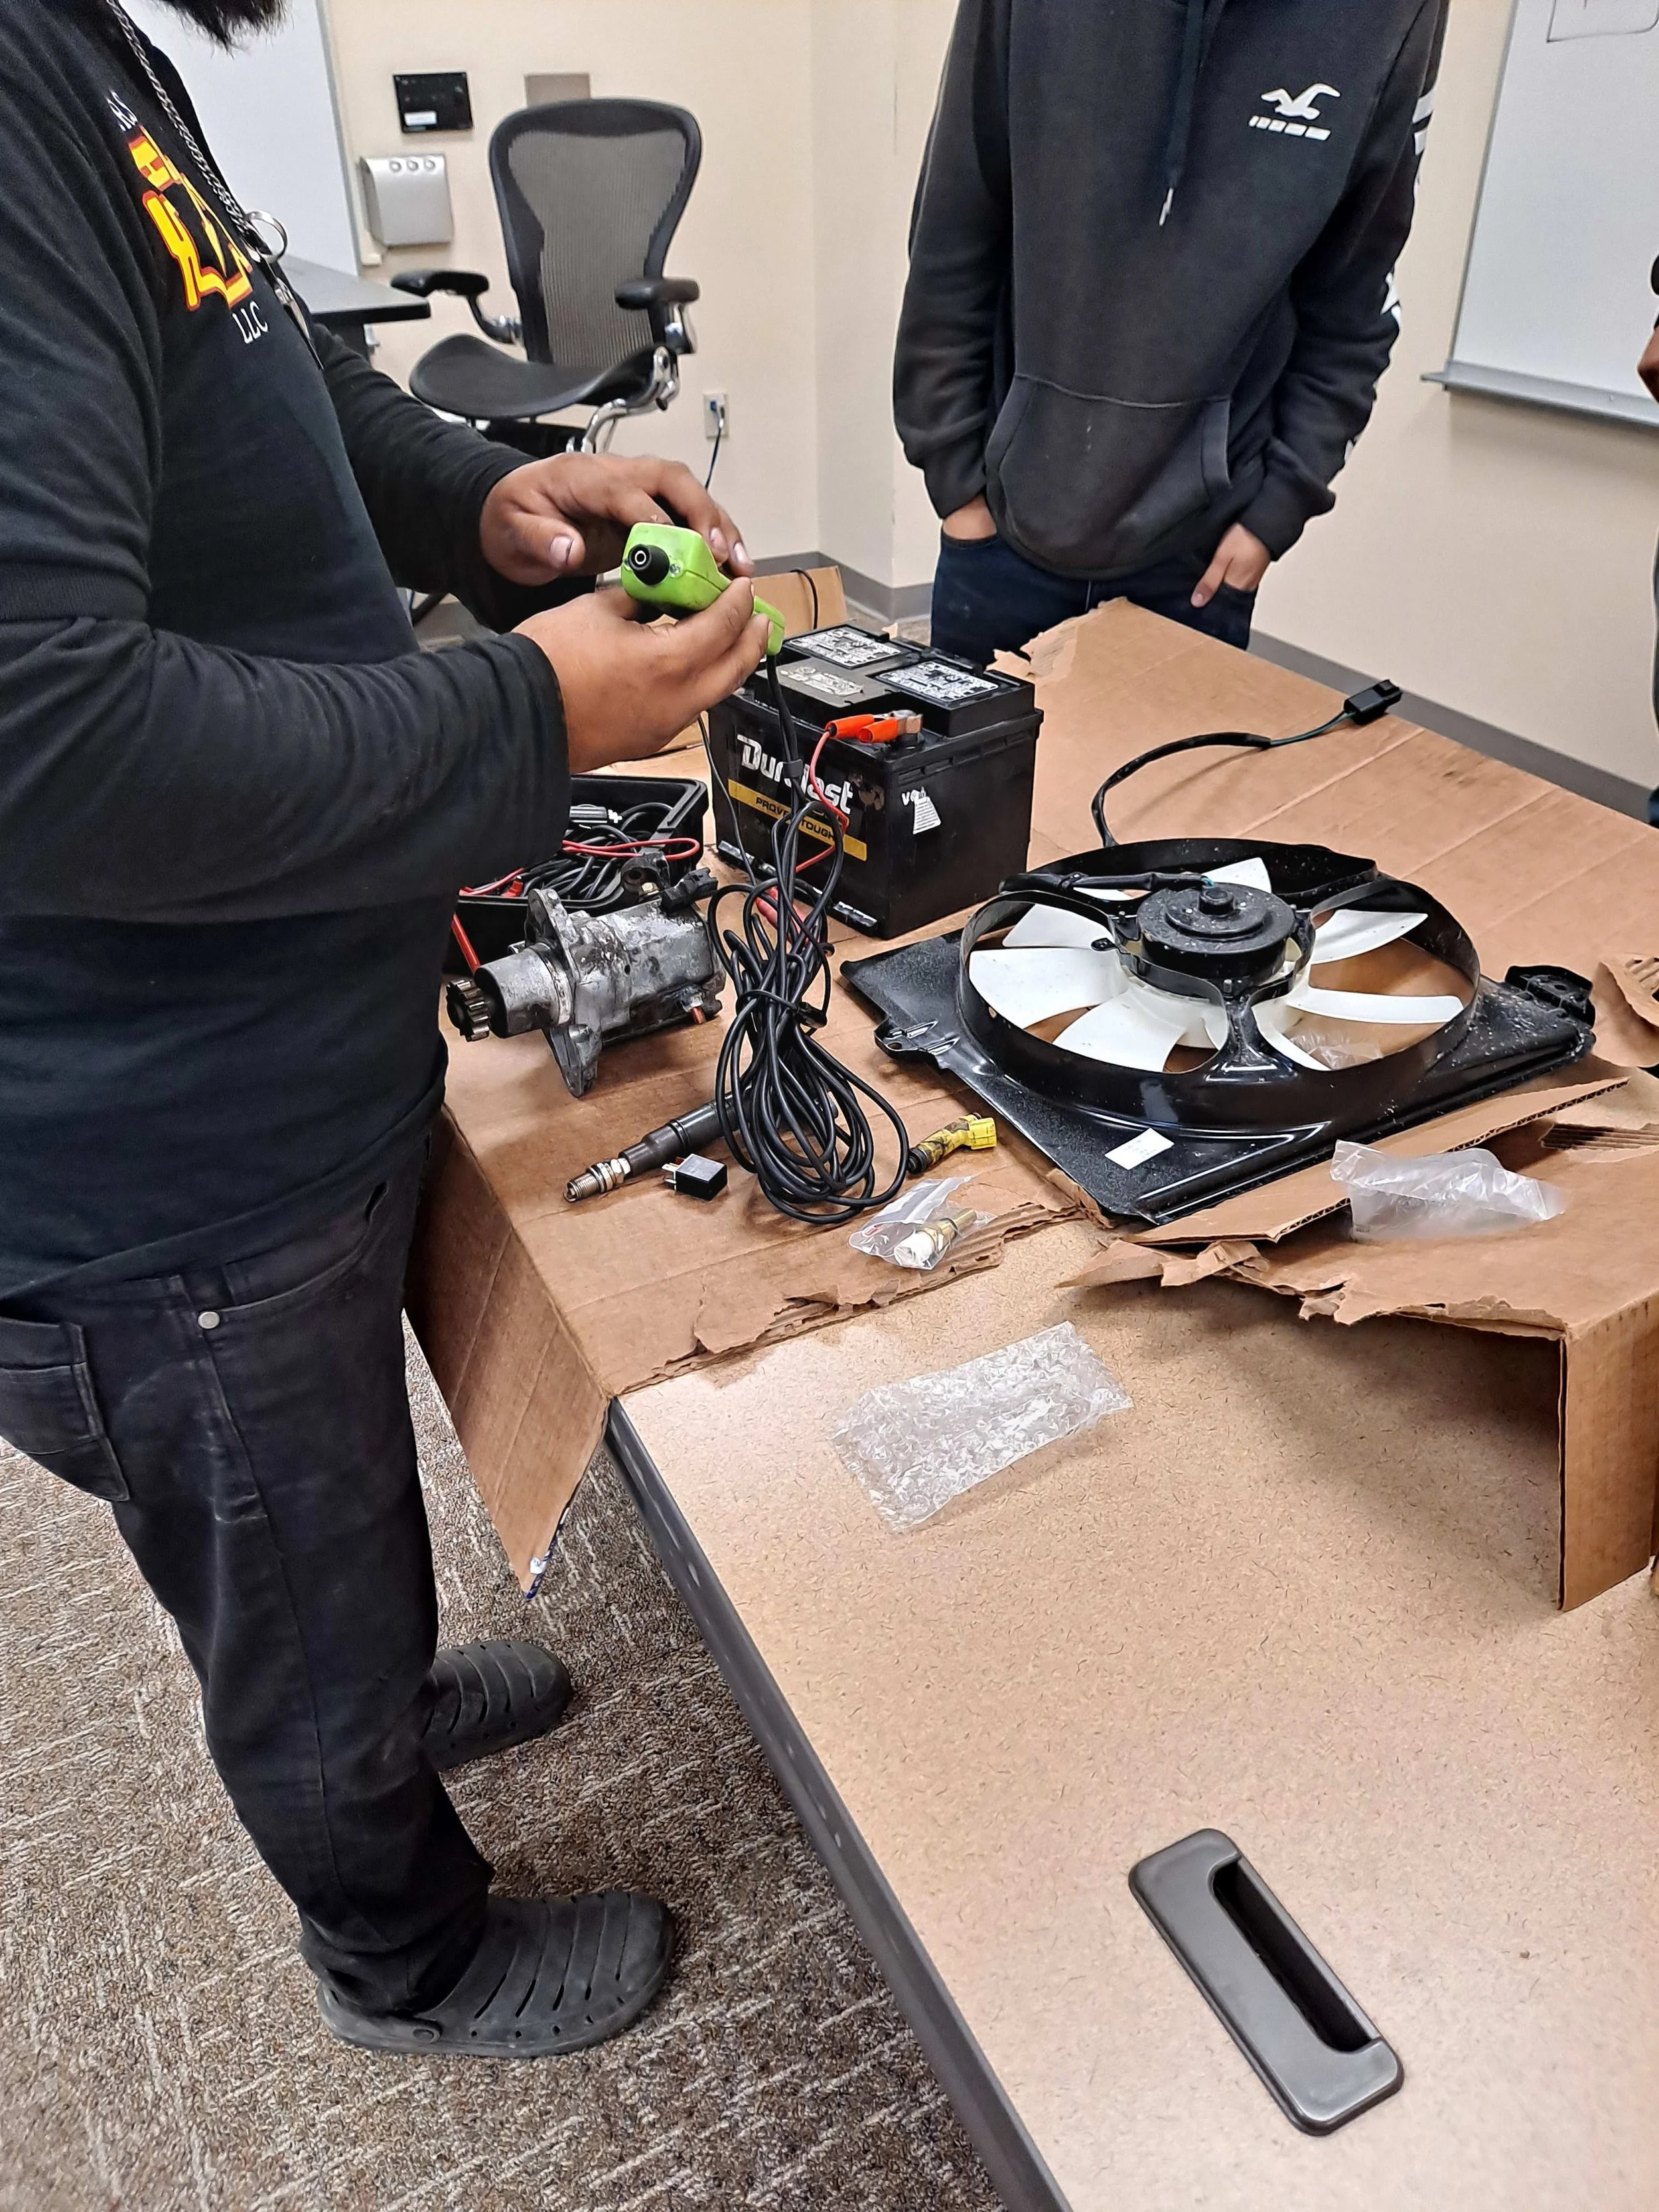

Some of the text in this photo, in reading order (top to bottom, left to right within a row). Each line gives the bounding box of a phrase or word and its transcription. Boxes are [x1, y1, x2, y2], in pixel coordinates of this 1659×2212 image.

[232, 301, 268, 344] LLC
[737, 734, 853, 815] Durlast
[755, 796, 790, 818] PROVE
